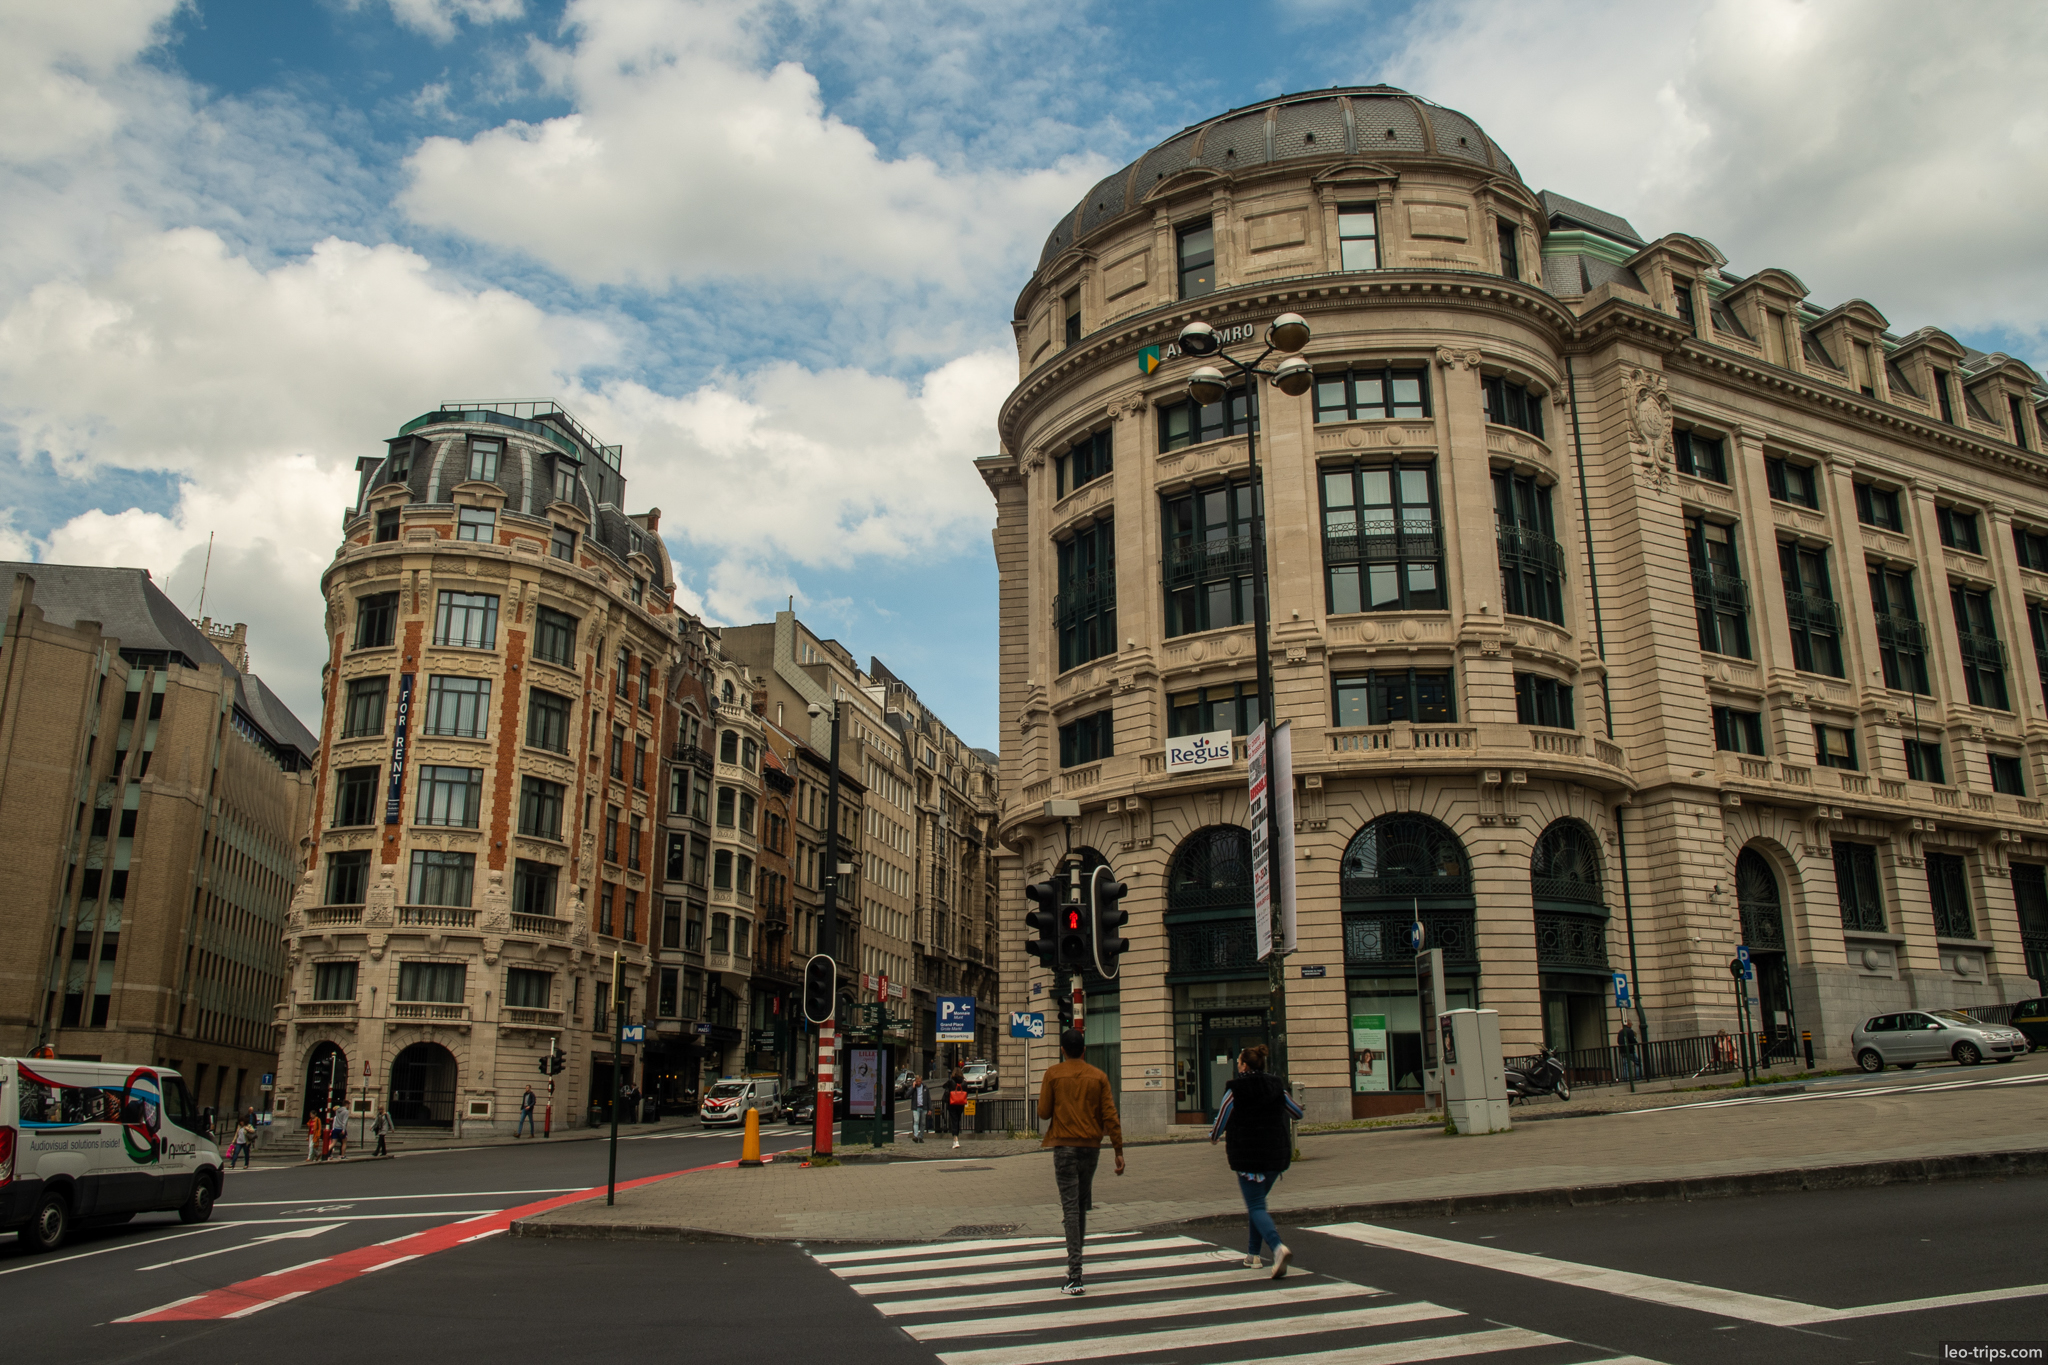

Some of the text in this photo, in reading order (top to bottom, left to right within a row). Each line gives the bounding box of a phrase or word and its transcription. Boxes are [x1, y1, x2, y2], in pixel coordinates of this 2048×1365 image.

[392, 690, 409, 785] FOR RENT
[1171, 745, 1229, 765] Regus
[1412, 929, 1420, 942] M
[1615, 977, 1626, 996] P
[942, 1001, 955, 1020] P
[1012, 1013, 1031, 1027] M
[622, 1027, 643, 1041] M
[478, 1070, 485, 1080] 2
[29, 1138, 121, 1151] Audiovisual solutions inside!
